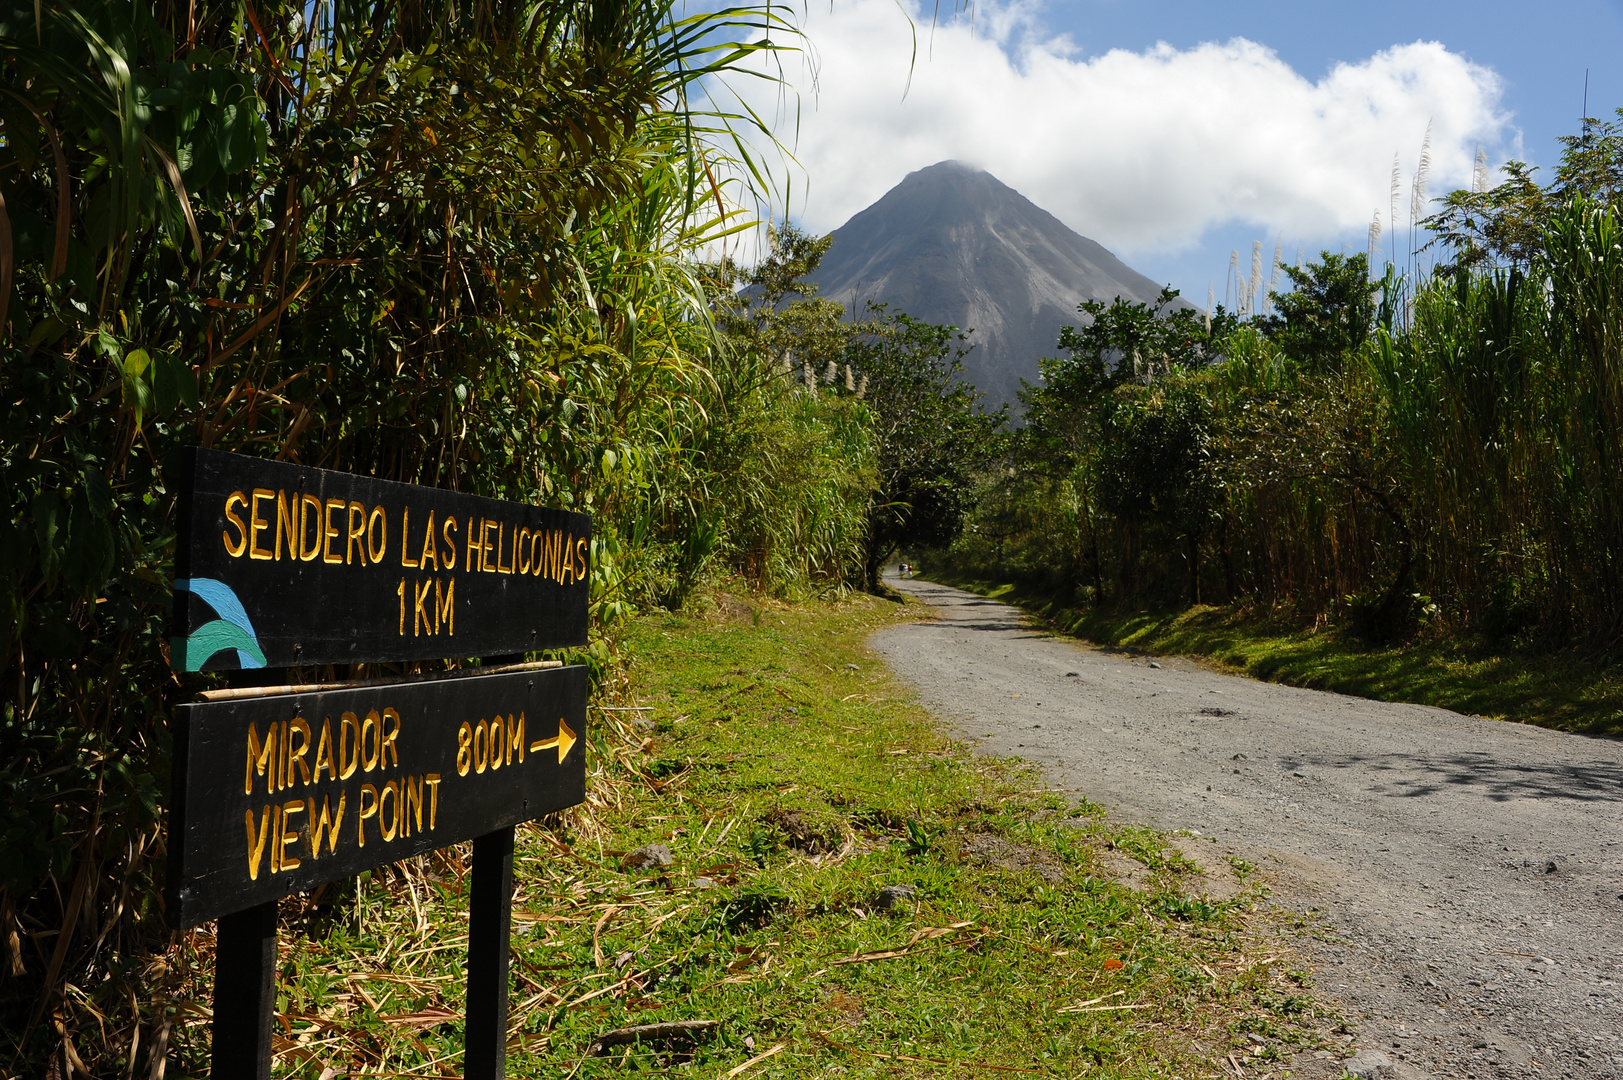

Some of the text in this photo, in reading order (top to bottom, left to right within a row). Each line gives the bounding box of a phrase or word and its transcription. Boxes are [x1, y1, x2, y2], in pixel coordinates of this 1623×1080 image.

[223, 488, 587, 585] SENDERO LAS HELICONIAS
[245, 707, 400, 795] MIRADOR
[457, 711, 525, 777] 800M
[245, 774, 441, 880] VIEW POINT
